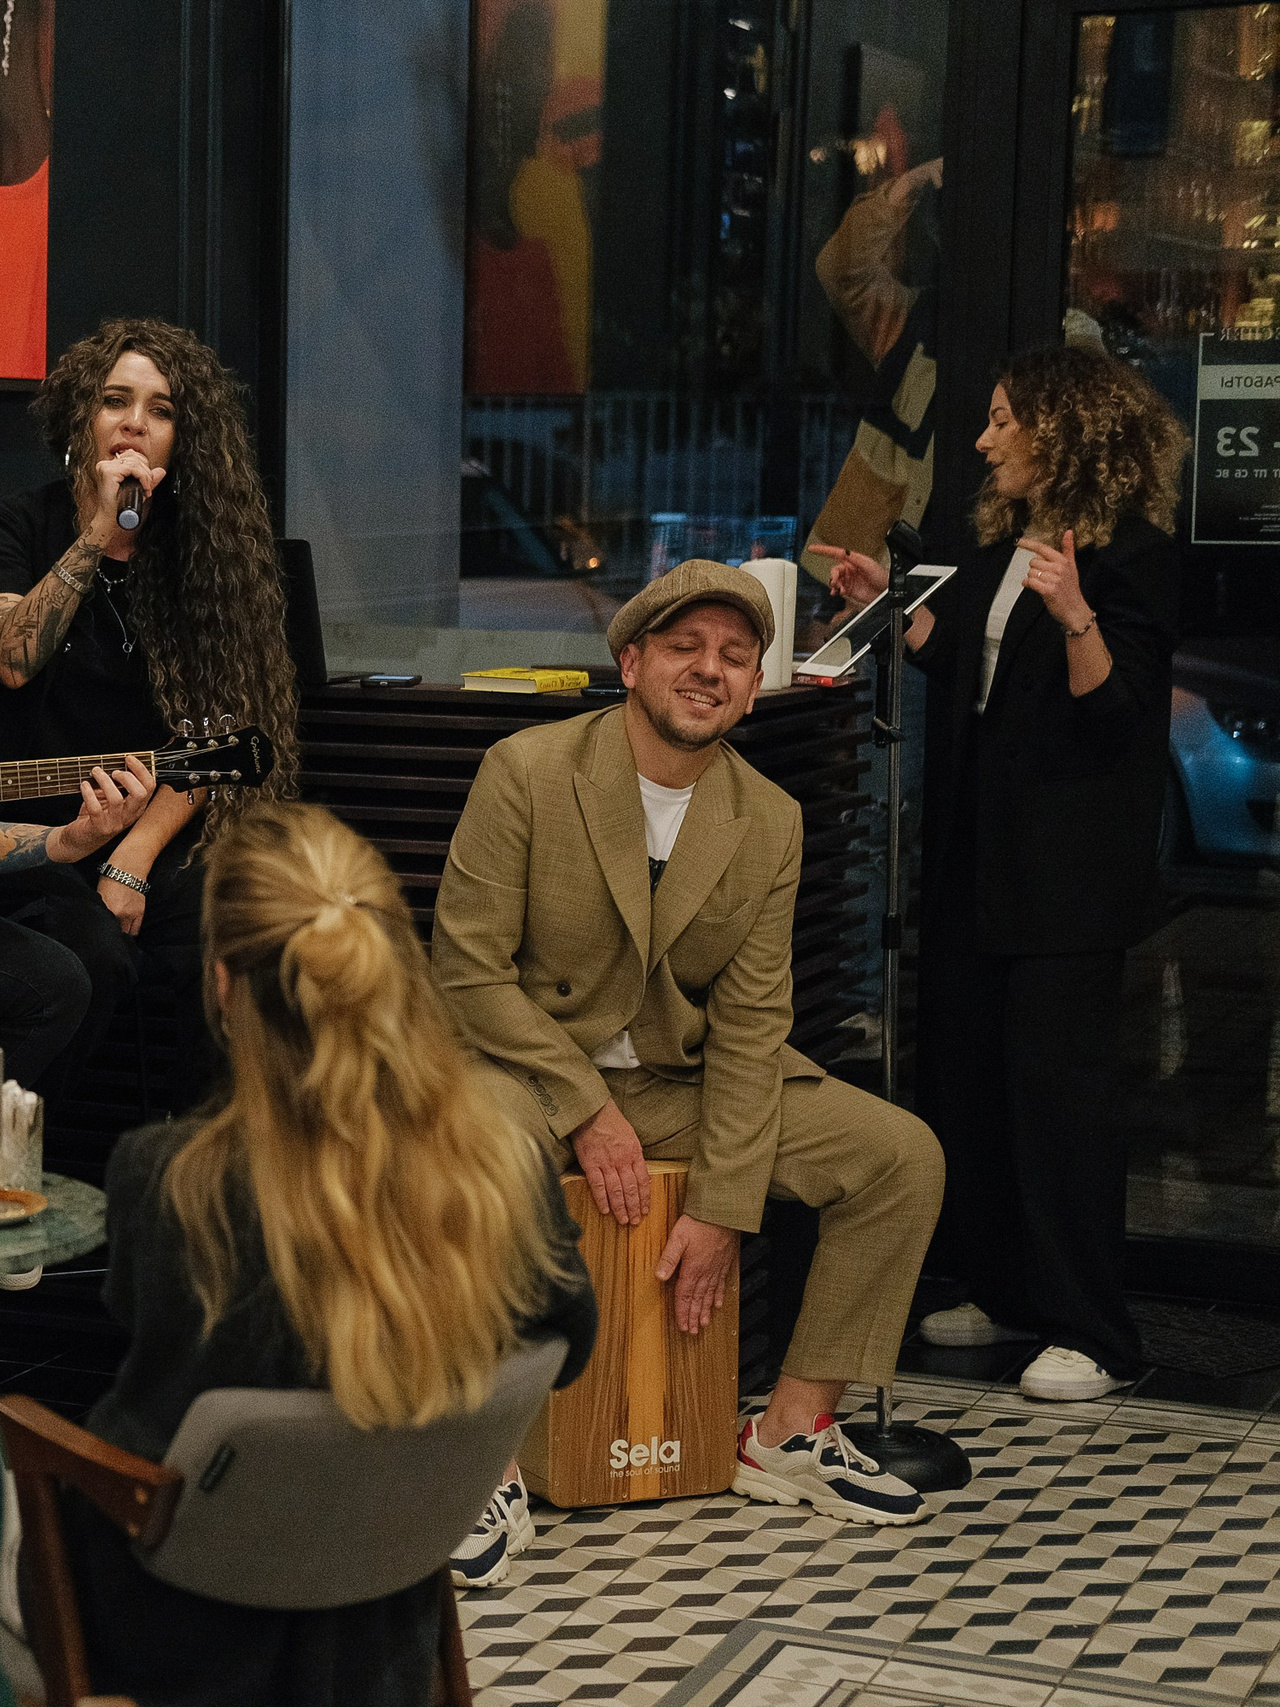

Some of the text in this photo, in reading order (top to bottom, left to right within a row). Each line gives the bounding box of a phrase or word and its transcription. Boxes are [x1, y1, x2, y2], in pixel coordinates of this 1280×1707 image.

[609, 1436, 681, 1469] Sela
[610, 1464, 680, 1478] the soul of sound
